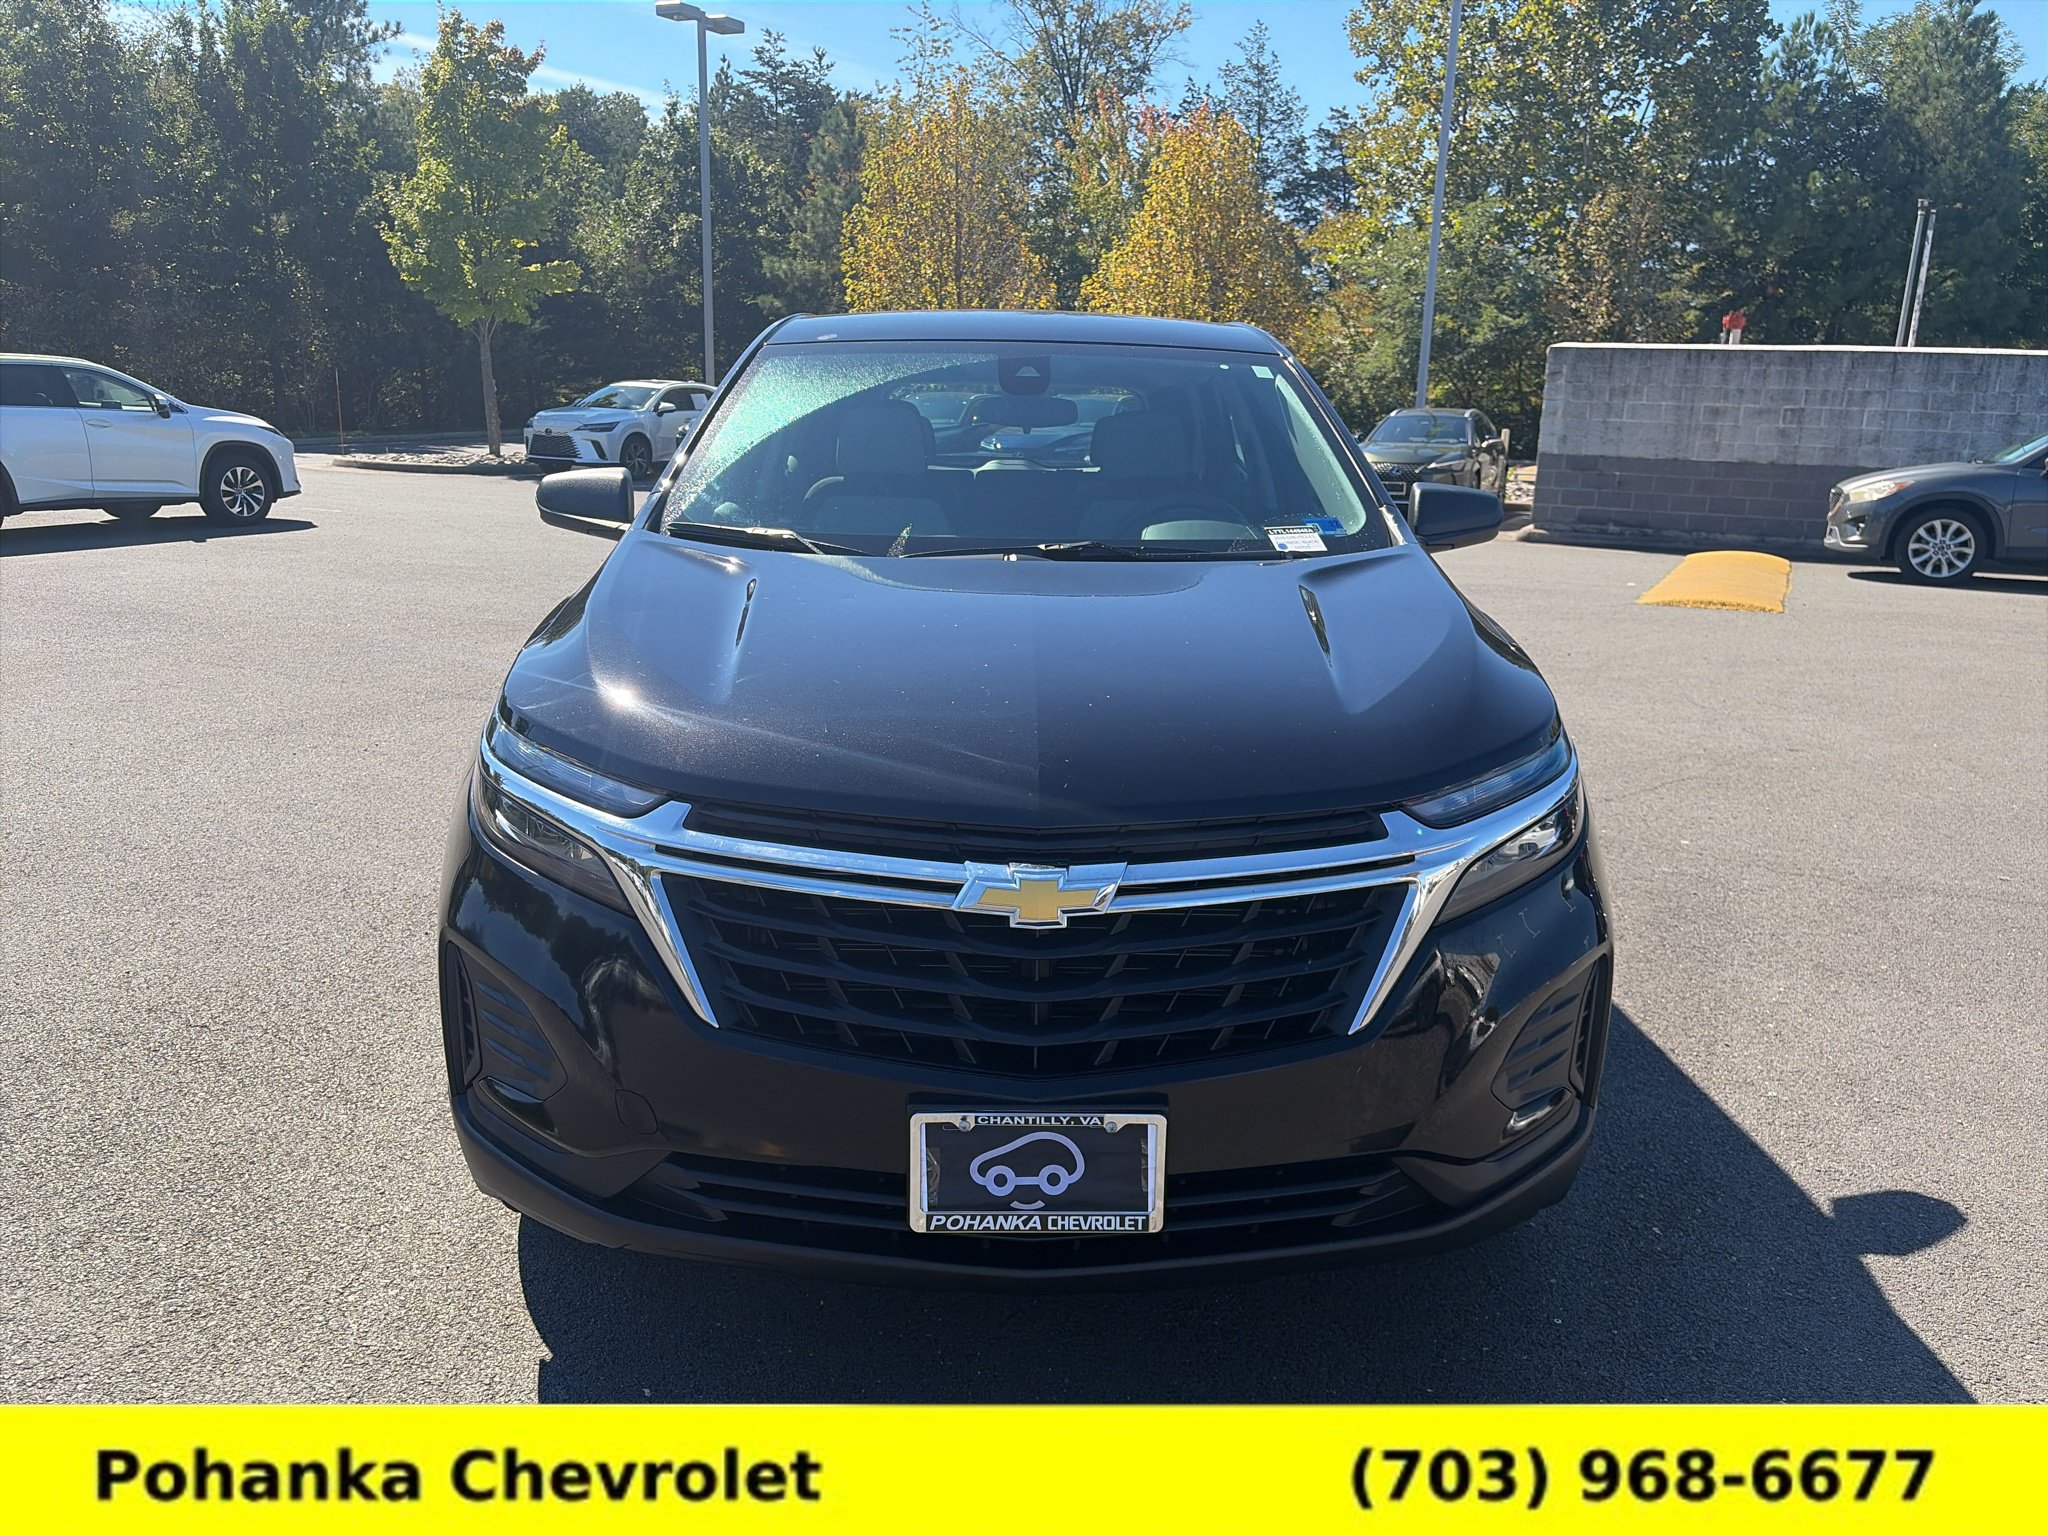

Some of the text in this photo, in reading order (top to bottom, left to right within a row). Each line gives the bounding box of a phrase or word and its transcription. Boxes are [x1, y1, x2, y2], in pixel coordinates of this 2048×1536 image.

[1079, 1115, 1102, 1126] VA
[929, 1215, 1147, 1231] POHANKA CHEVROLET
